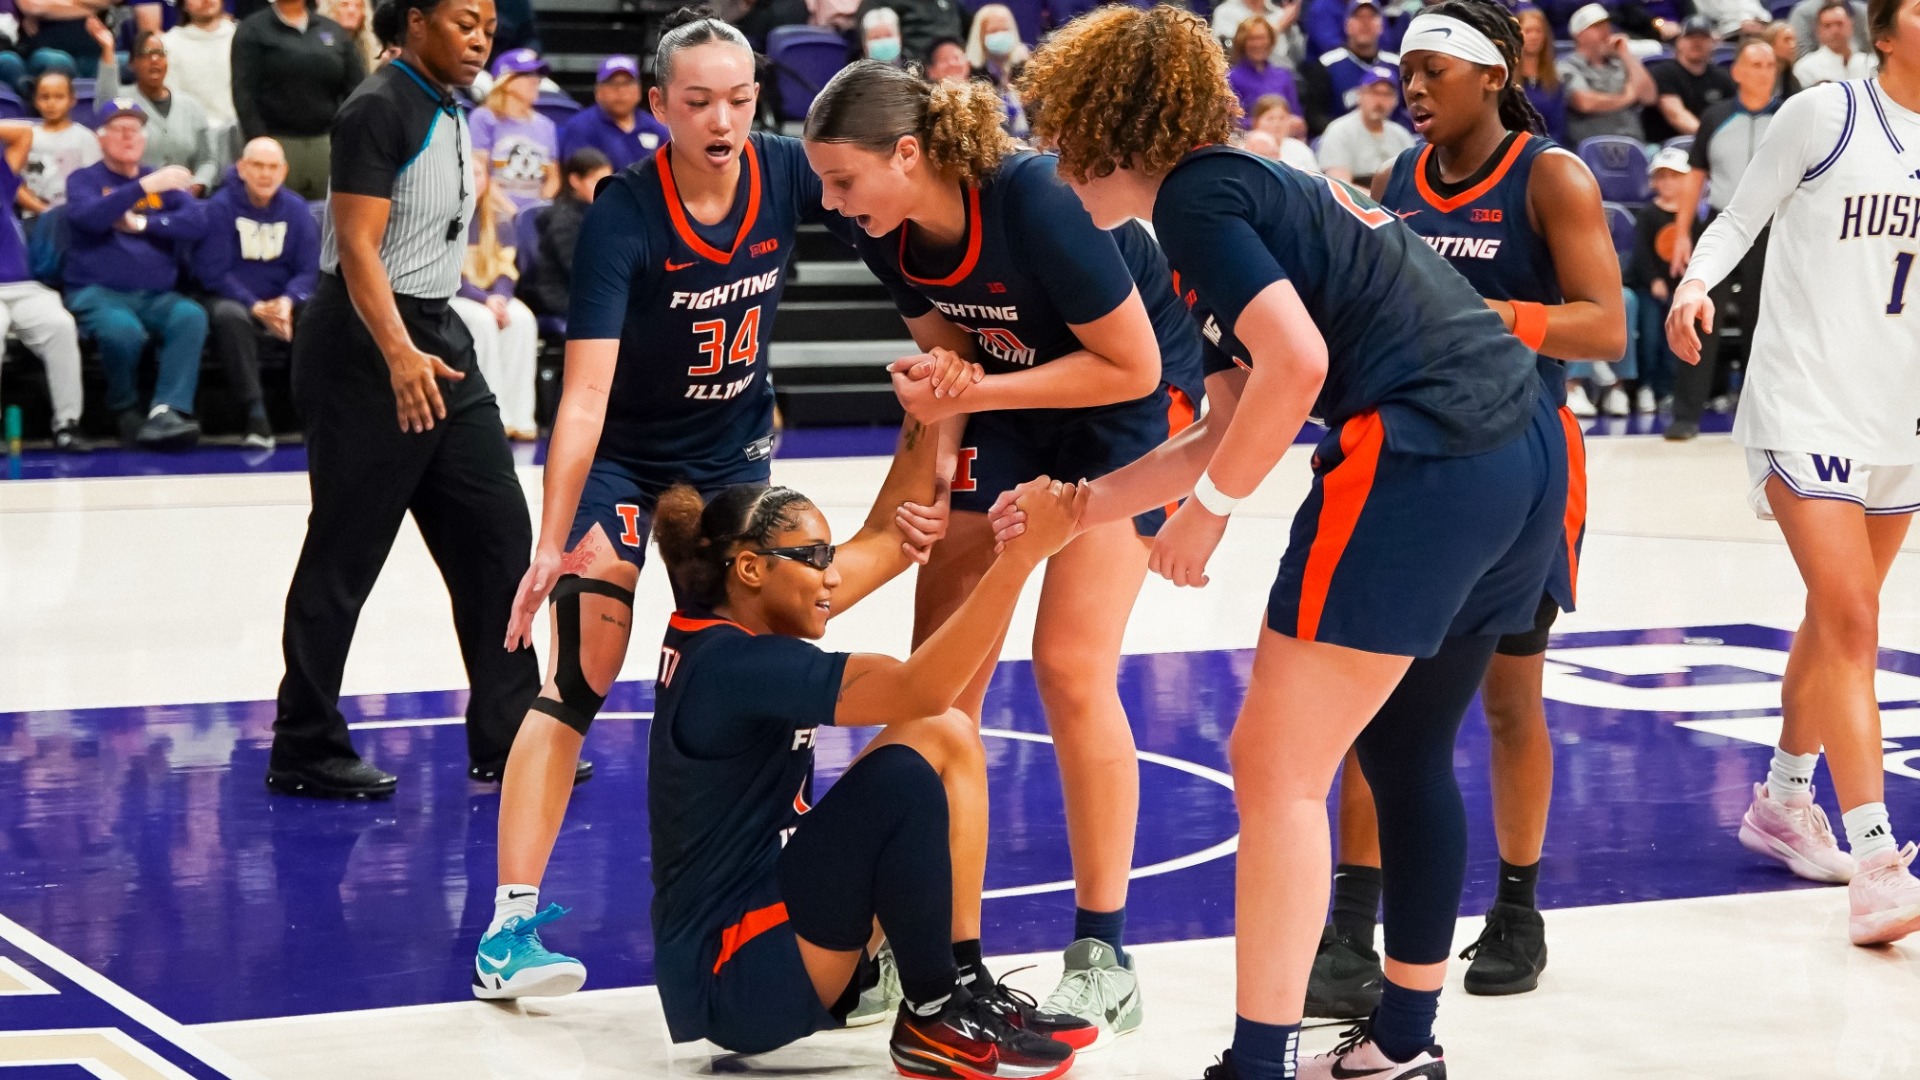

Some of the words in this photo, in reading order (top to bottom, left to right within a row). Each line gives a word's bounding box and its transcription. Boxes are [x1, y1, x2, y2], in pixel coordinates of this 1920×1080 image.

[1421, 236, 1502, 260] HTING
[669, 267, 779, 310] FIGHTING
[927, 297, 1019, 321] GHTING
[687, 304, 762, 377] 34
[684, 371, 755, 400] ILLINI
[1811, 453, 1852, 484] W
